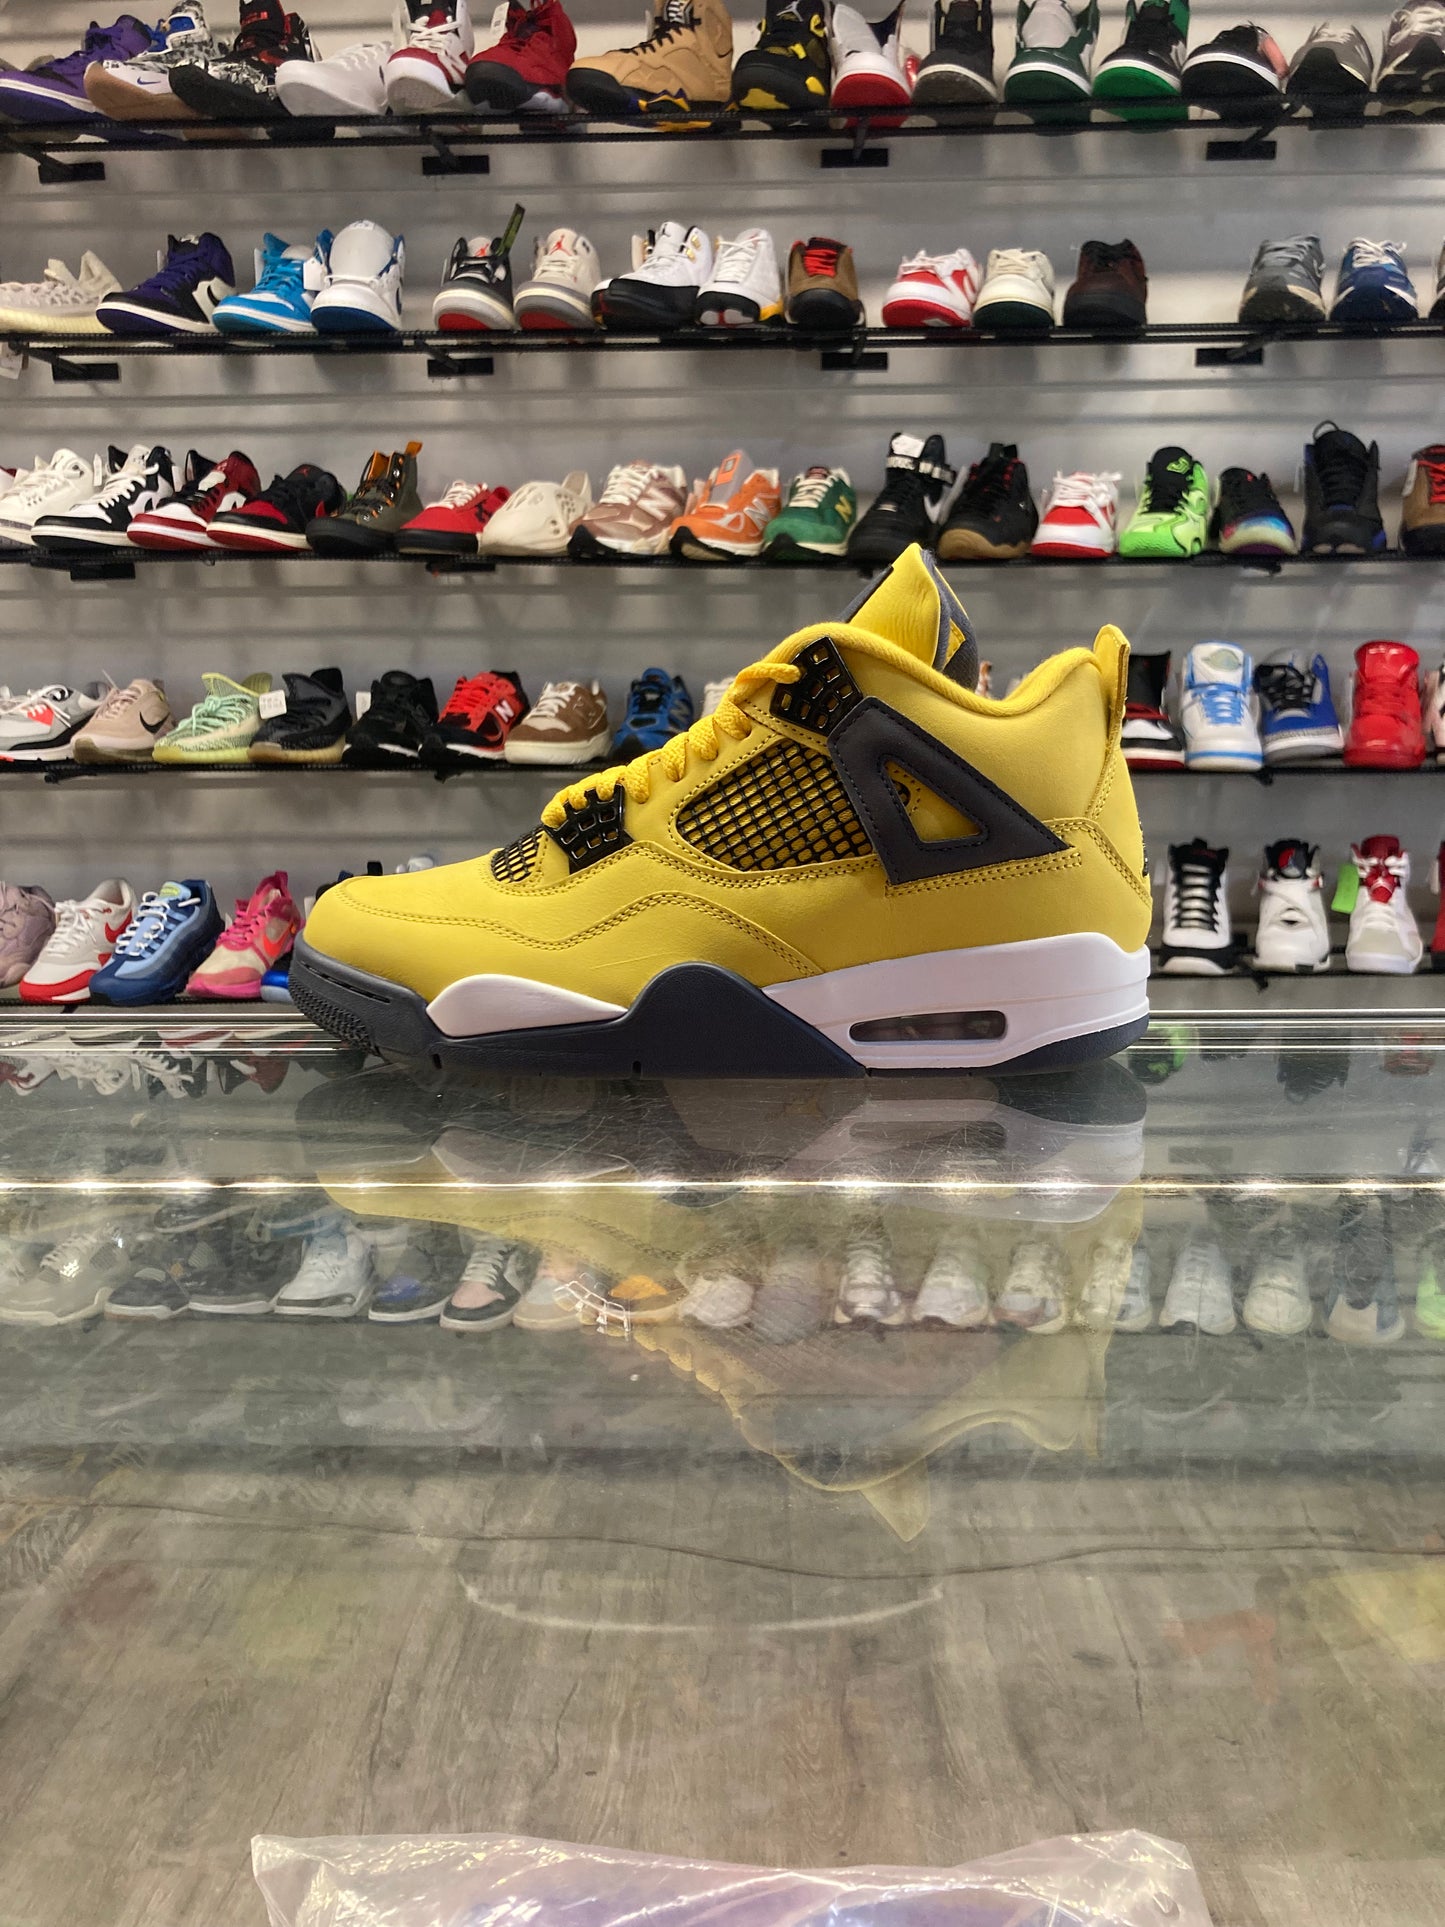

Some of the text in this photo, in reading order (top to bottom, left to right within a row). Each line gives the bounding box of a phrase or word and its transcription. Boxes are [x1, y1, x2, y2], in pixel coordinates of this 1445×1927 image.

[636, 487, 676, 521] N
[835, 496, 852, 523] N
[495, 700, 514, 723] N
